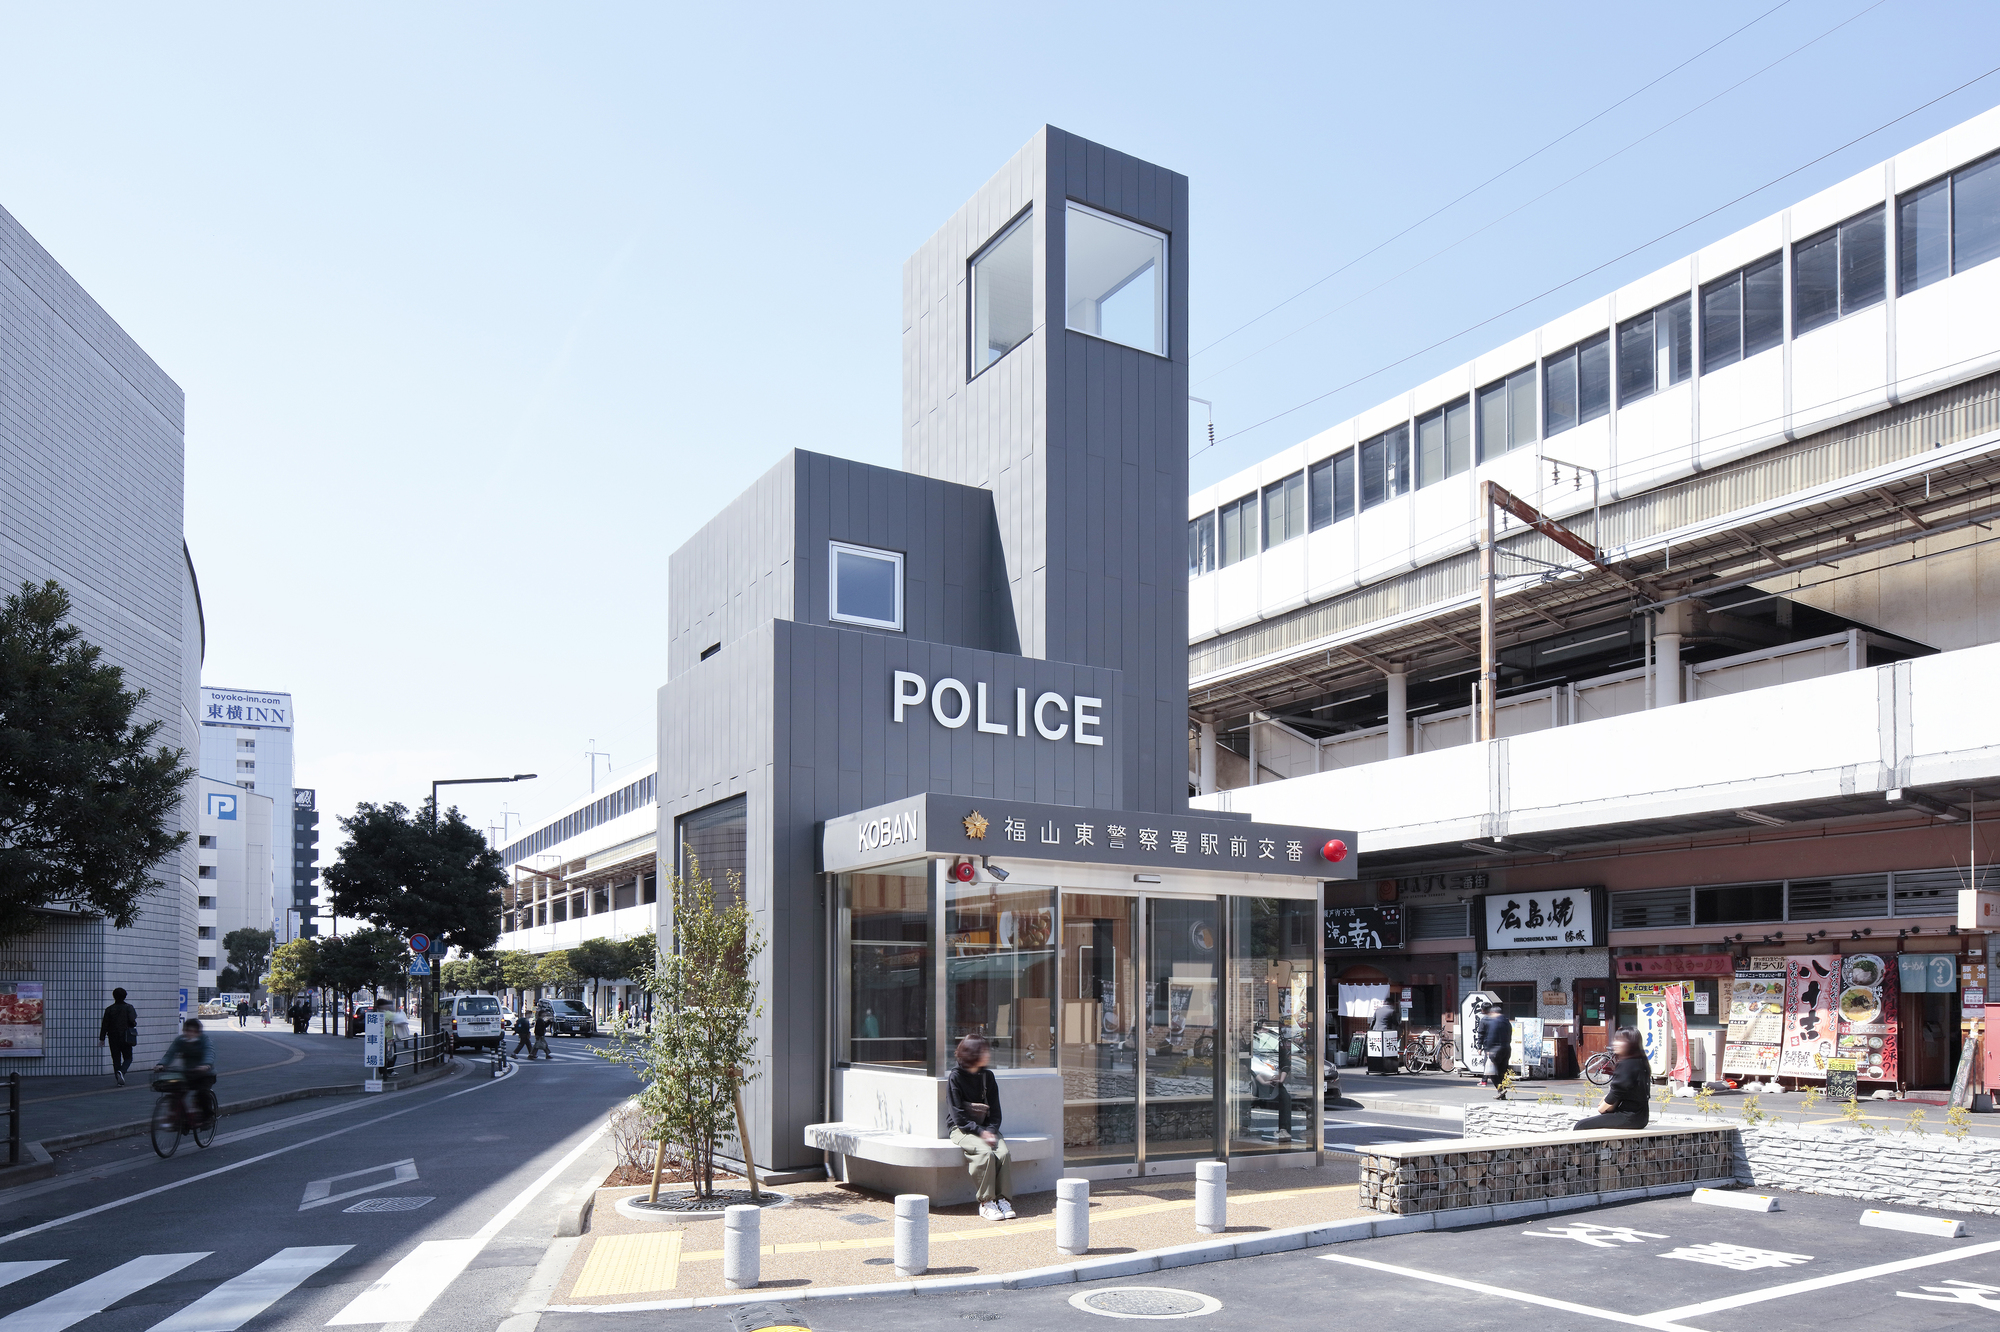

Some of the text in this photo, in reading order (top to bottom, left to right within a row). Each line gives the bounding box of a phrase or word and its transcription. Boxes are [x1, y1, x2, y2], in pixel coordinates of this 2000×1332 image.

[206, 703, 286, 724] 東横INN
[211, 692, 281, 705] toyoko-inn.com
[894, 670, 1104, 746] POLICE
[210, 795, 235, 819] P
[858, 811, 918, 853] KOBAN
[1004, 815, 1303, 863] 福山東警察署駅前交番
[1450, 874, 1489, 890] 二番街
[1497, 897, 1575, 934] 広島焼
[1753, 962, 1785, 970] 黒ラベル
[1902, 961, 1925, 971] らーめん
[1623, 984, 1664, 992] サッポロ生ビル
[366, 1013, 378, 1066] 降車場
[1642, 1002, 1655, 1061] ラーメン
[1521, 1222, 1815, 1271] 交番
